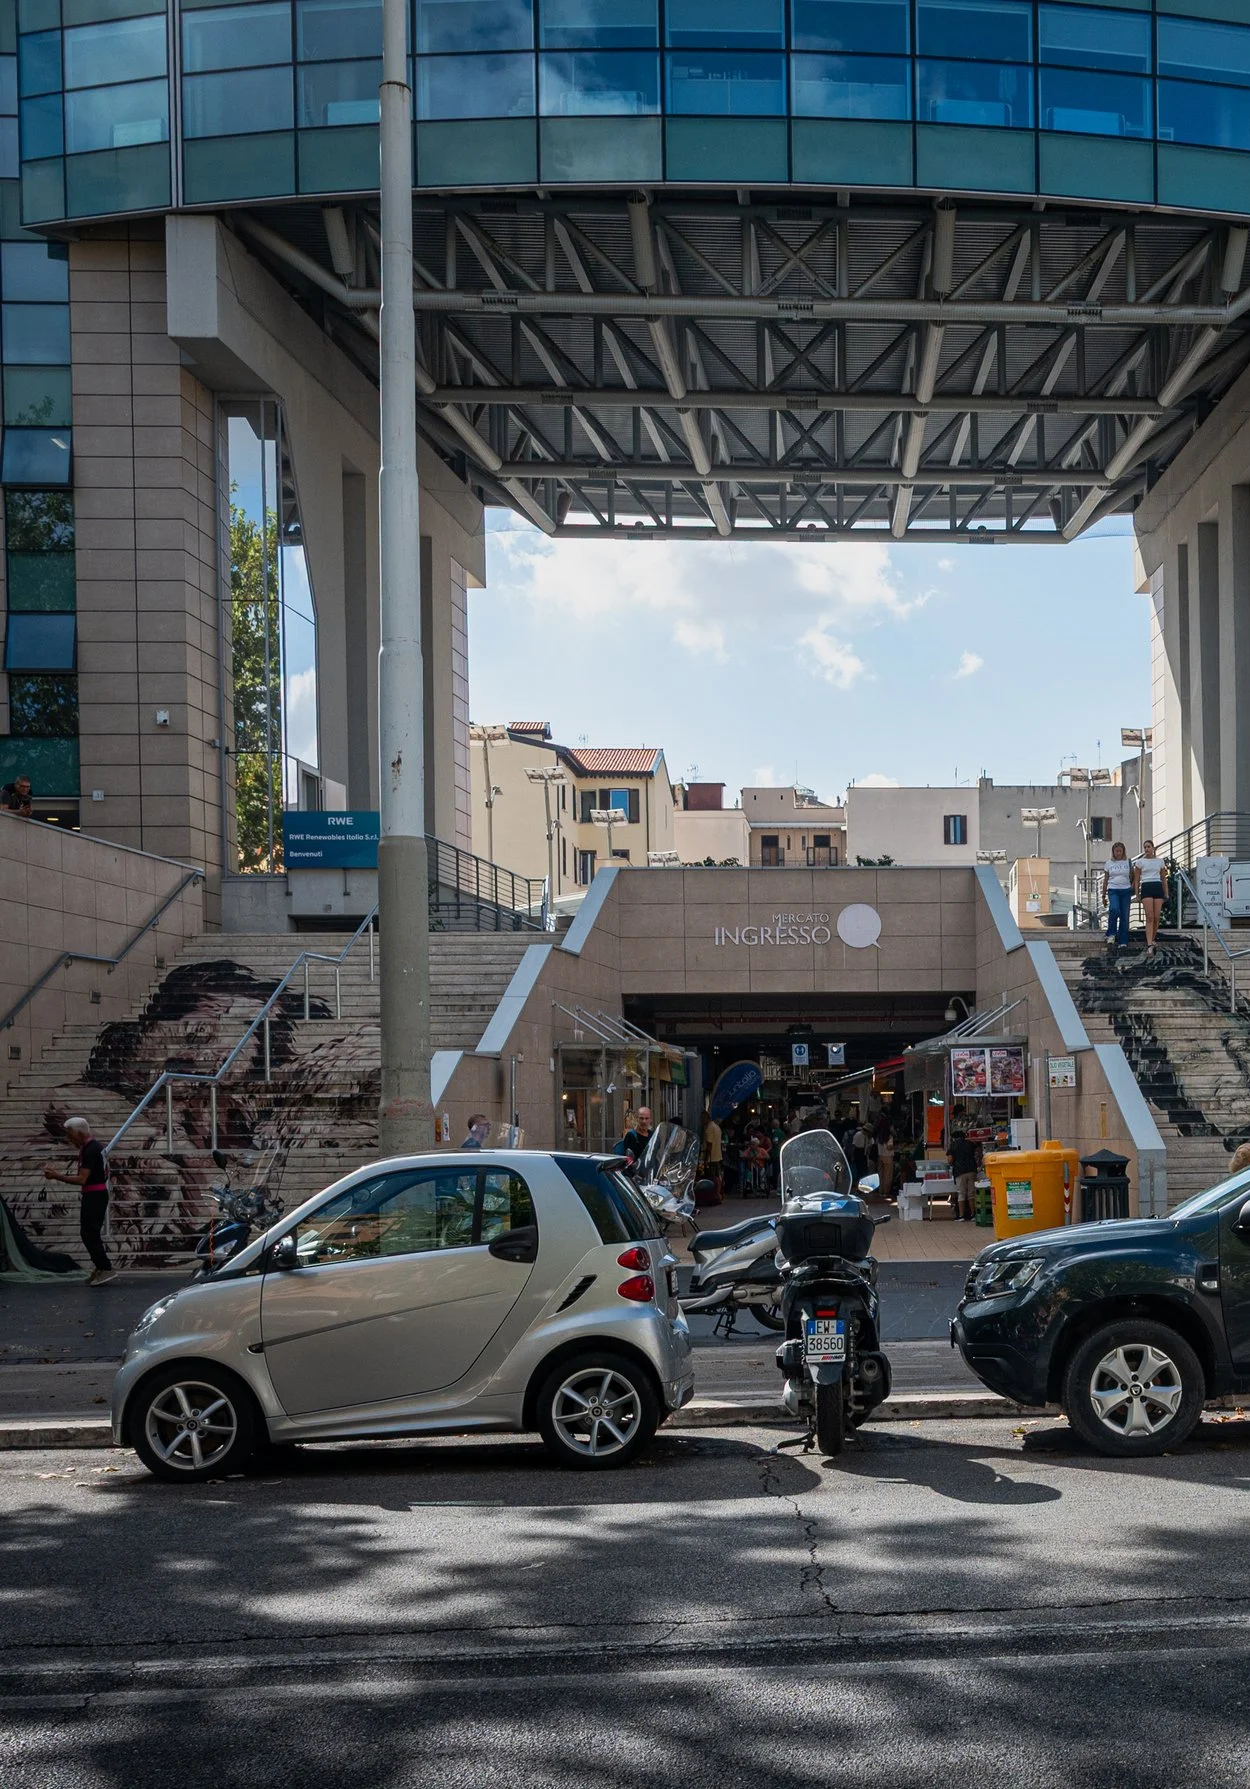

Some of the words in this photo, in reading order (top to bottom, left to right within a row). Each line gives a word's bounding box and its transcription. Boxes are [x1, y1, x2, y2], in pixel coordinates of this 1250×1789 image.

[327, 816, 354, 825] RWE
[772, 912, 830, 924] MERCATO
[714, 925, 832, 946] INGRESSO
[816, 1320, 830, 1334] EW
[809, 1337, 844, 1351] 38560
